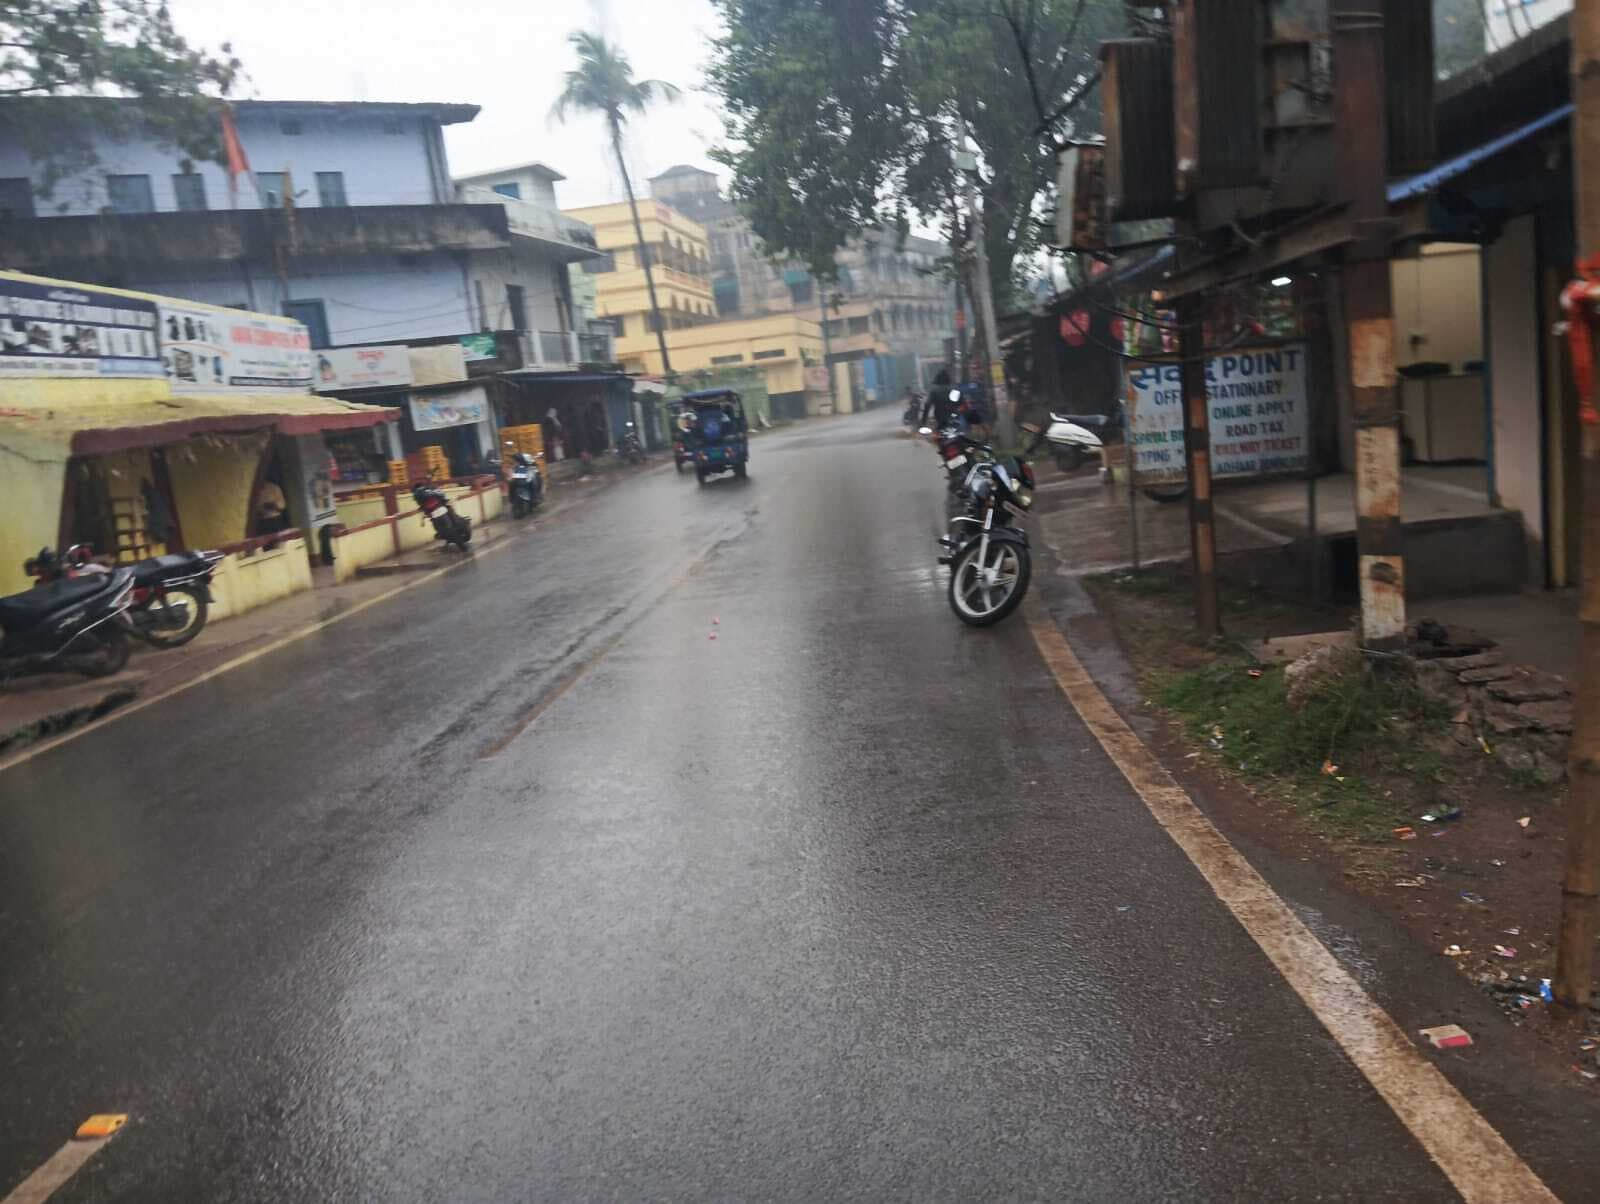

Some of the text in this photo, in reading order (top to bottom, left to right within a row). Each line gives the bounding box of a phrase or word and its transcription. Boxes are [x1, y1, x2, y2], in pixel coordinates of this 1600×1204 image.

[1221, 349, 1298, 378] POINT
[1213, 401, 1294, 419] ONLINE APPLY
[1225, 420, 1285, 437] ROAD TAX
